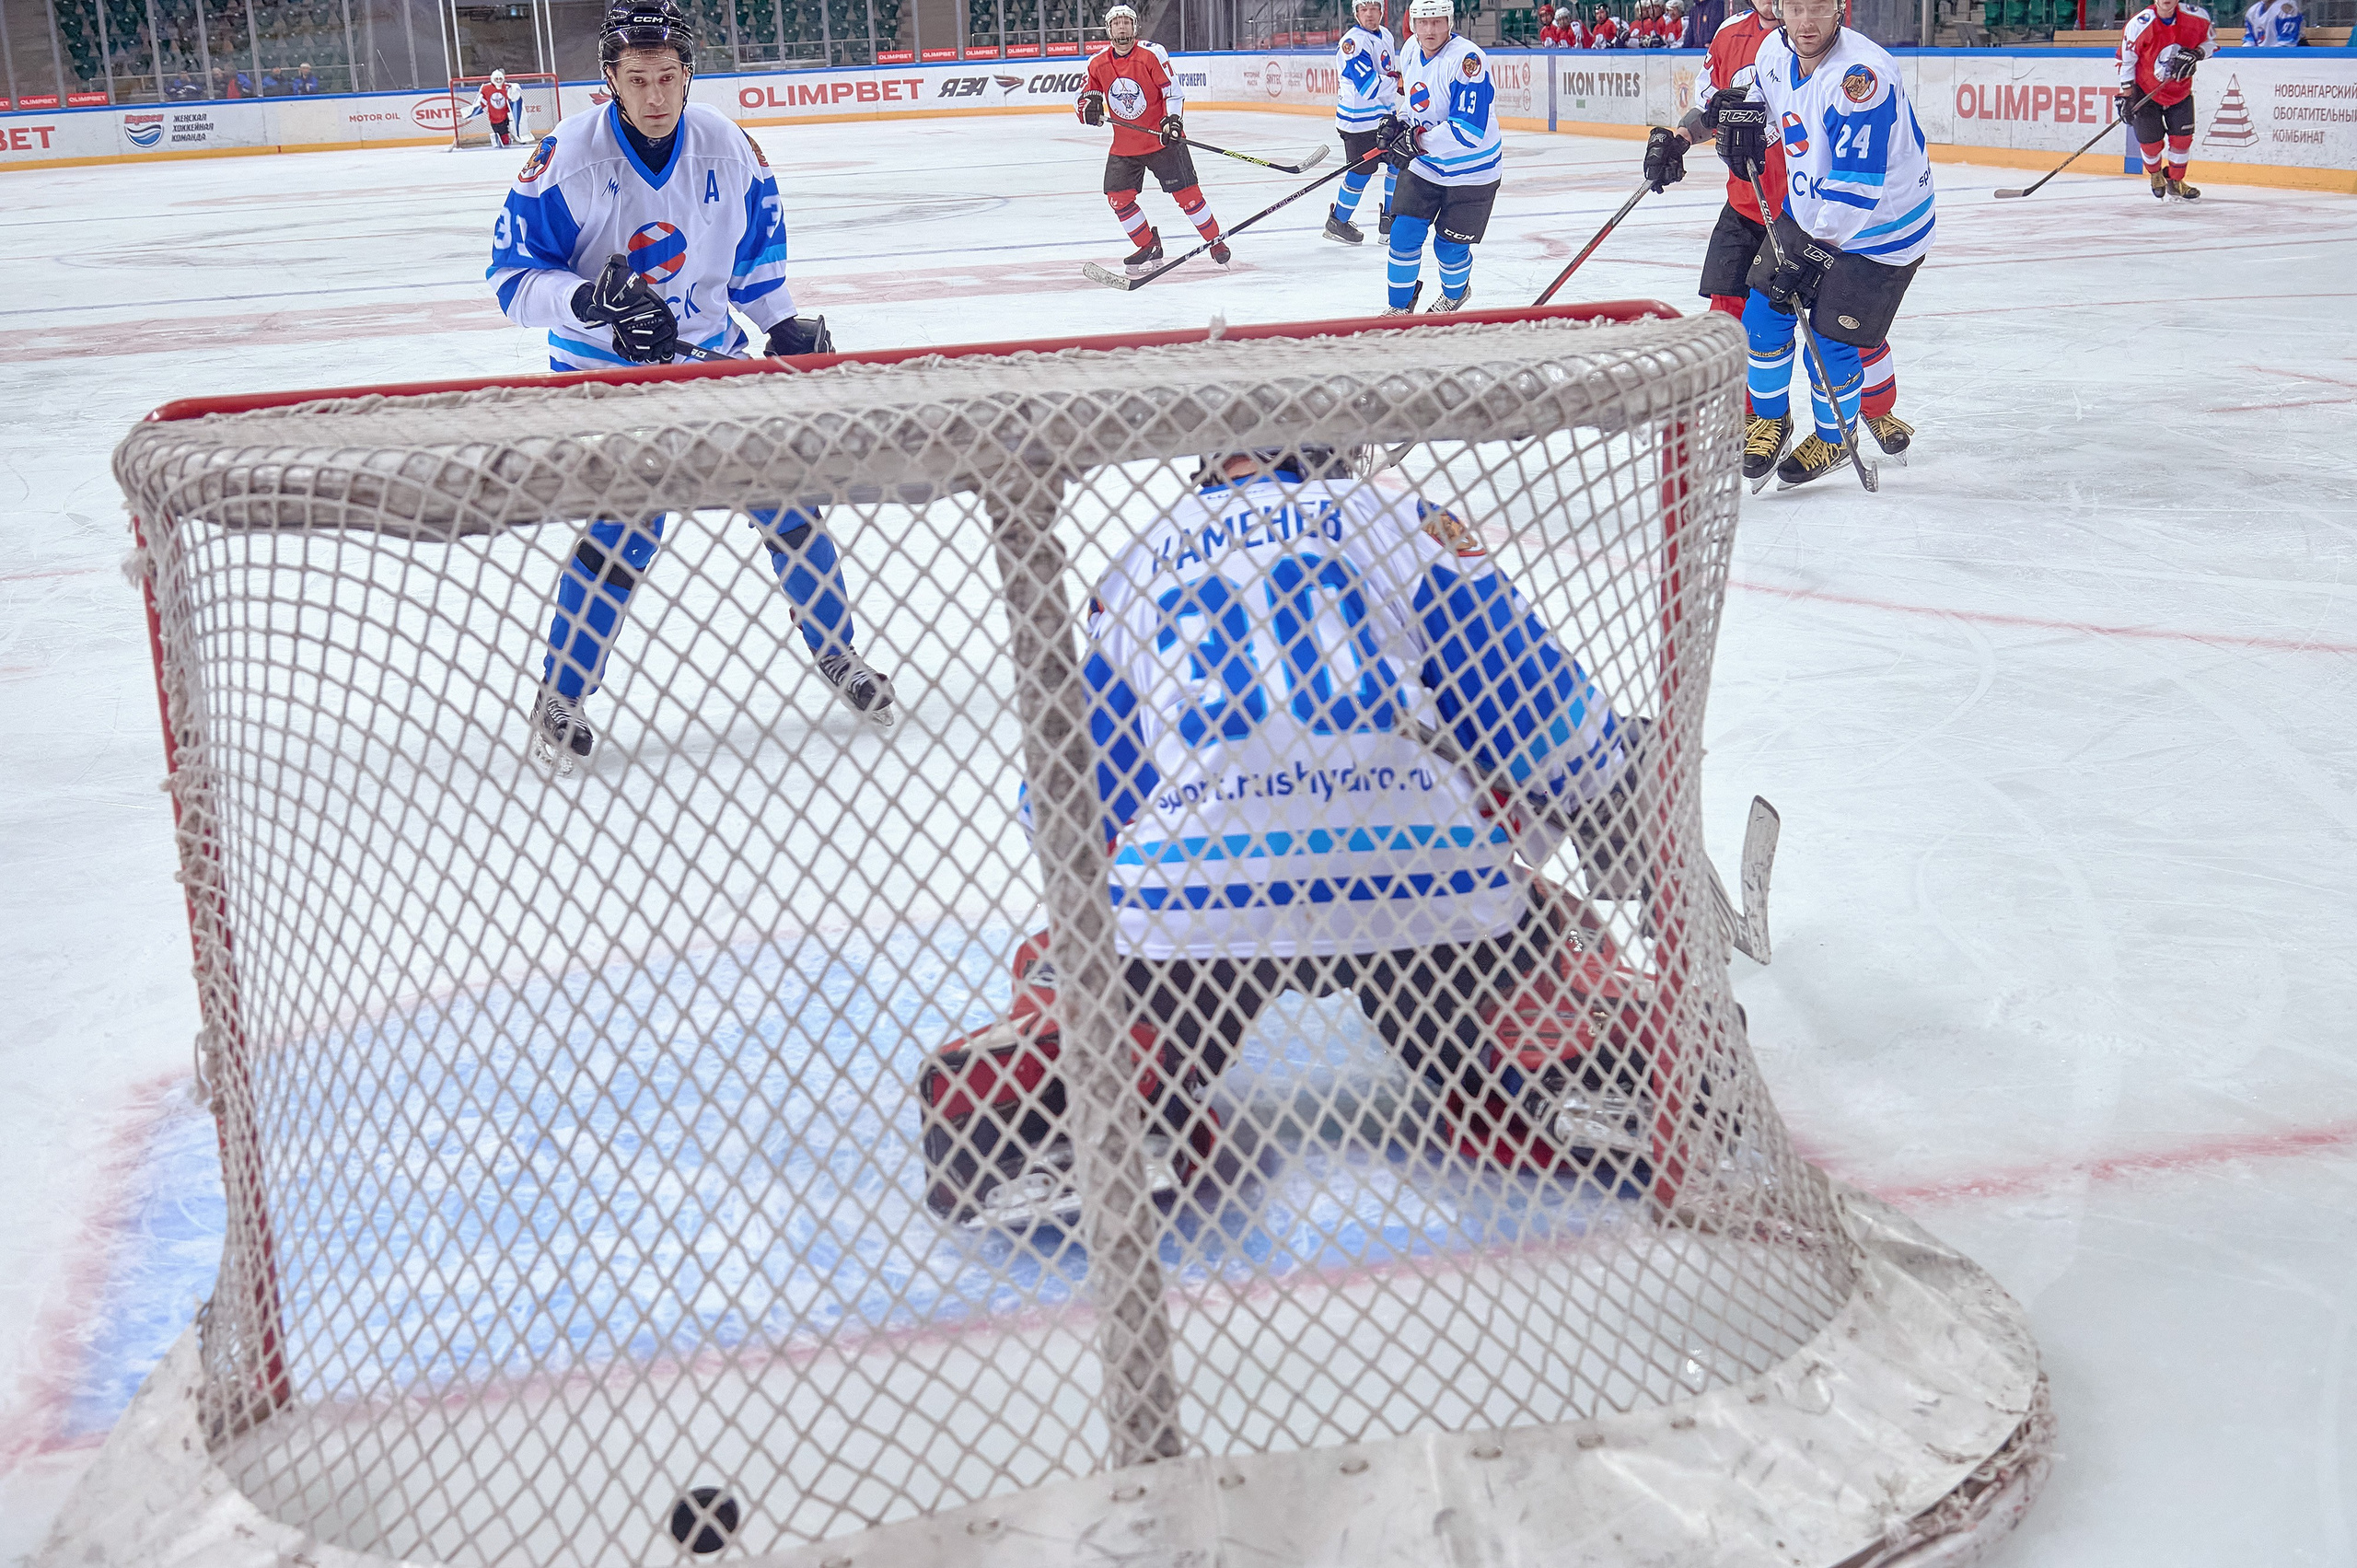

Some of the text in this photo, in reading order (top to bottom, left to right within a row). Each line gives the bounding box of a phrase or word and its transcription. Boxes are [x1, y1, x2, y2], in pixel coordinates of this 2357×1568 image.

[965, 48, 998, 56] OLIMPBET
[738, 78, 924, 109] OLIMPBET
[1563, 72, 1641, 98] IKON TYRES
[2274, 82, 2357, 99] НОВОАНГАРСКИЙ
[1457, 90, 1477, 115] 13
[1956, 83, 2121, 124] OLIMPBET
[173, 113, 207, 122] ЖЕНСКАЯ
[349, 112, 401, 122] MOTOR OIL
[1719, 110, 1767, 123] CCM
[172, 122, 215, 132] ХОККЕЙНАЯ
[171, 133, 206, 142] КОМАНДА
[1835, 123, 1872, 159] 24
[2272, 129, 2326, 144] КОМБИНАТ
[1223, 149, 1271, 167] FISCHER
[703, 169, 720, 204] A
[1761, 200, 1774, 225] CCM
[493, 205, 534, 259] 31
[1444, 227, 1476, 241] CCM
